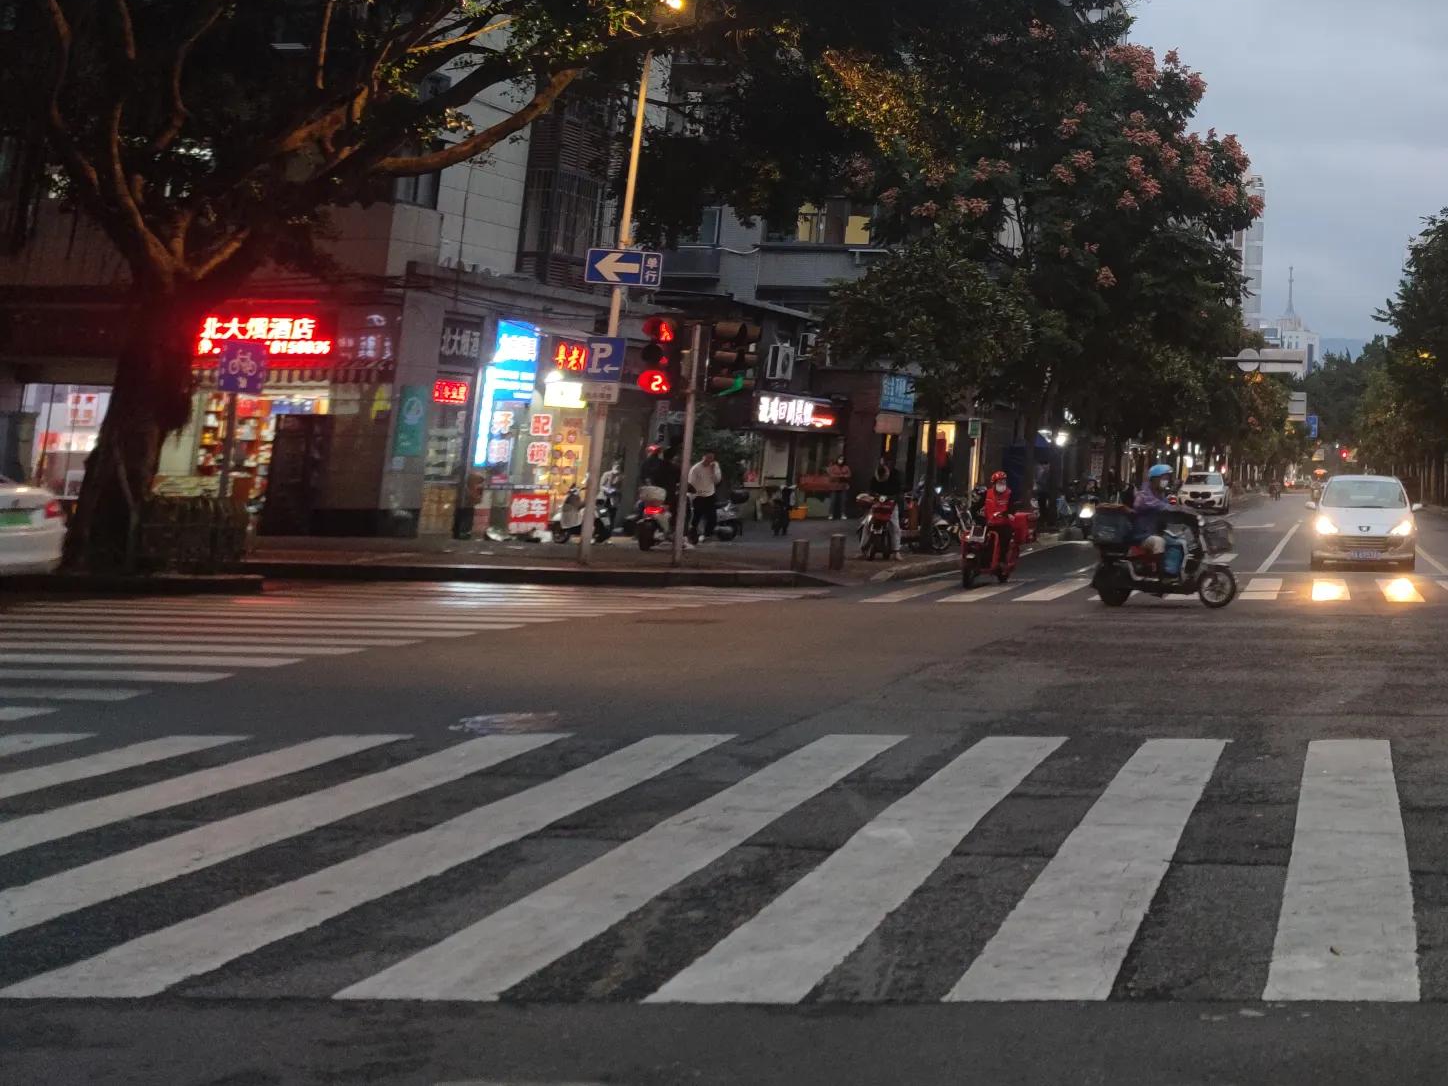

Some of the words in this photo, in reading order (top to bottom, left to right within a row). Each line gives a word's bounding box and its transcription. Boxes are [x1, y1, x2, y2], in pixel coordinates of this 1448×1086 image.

[643, 257, 658, 283] 单行
[200, 317, 316, 339] 北大烟酒店
[588, 343, 613, 374] P
[510, 497, 549, 520] 修车
